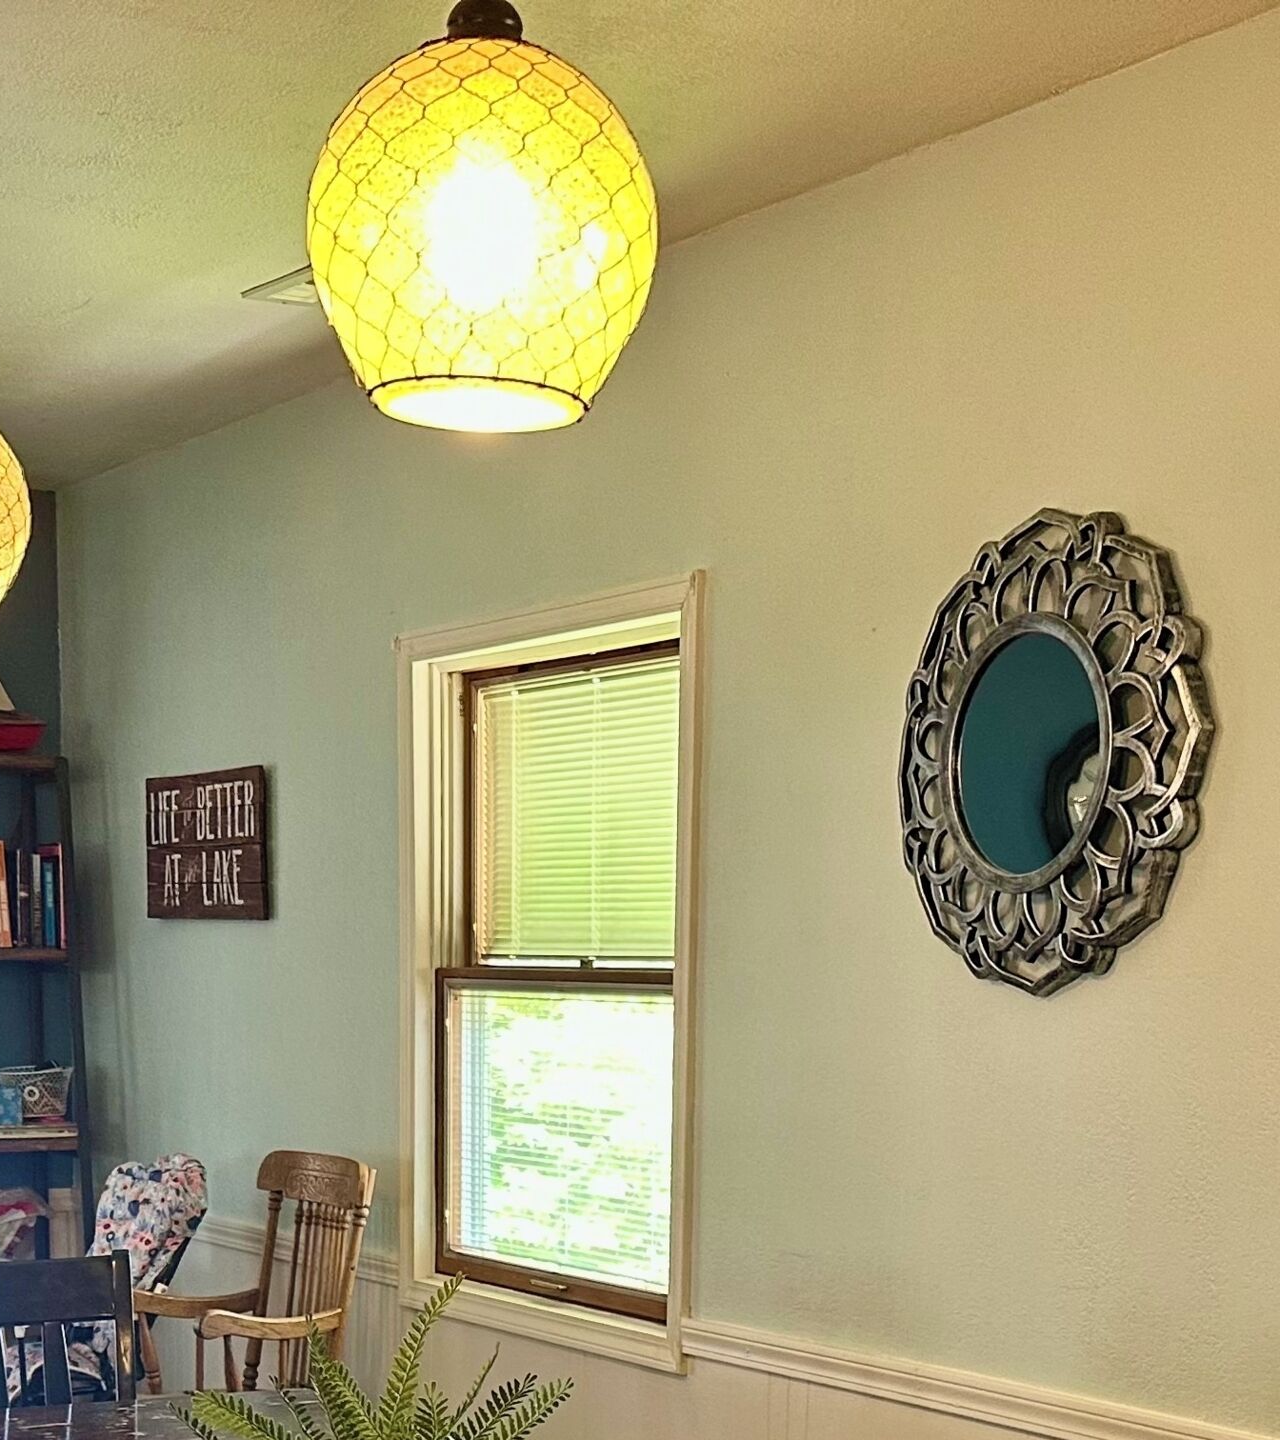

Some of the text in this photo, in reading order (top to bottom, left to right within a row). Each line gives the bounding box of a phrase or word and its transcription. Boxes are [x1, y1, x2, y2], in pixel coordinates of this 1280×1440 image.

[150, 790, 181, 846] LIFE
[196, 779, 255, 841] BETTER
[163, 853, 182, 907] AT
[201, 849, 245, 907] LAKE
